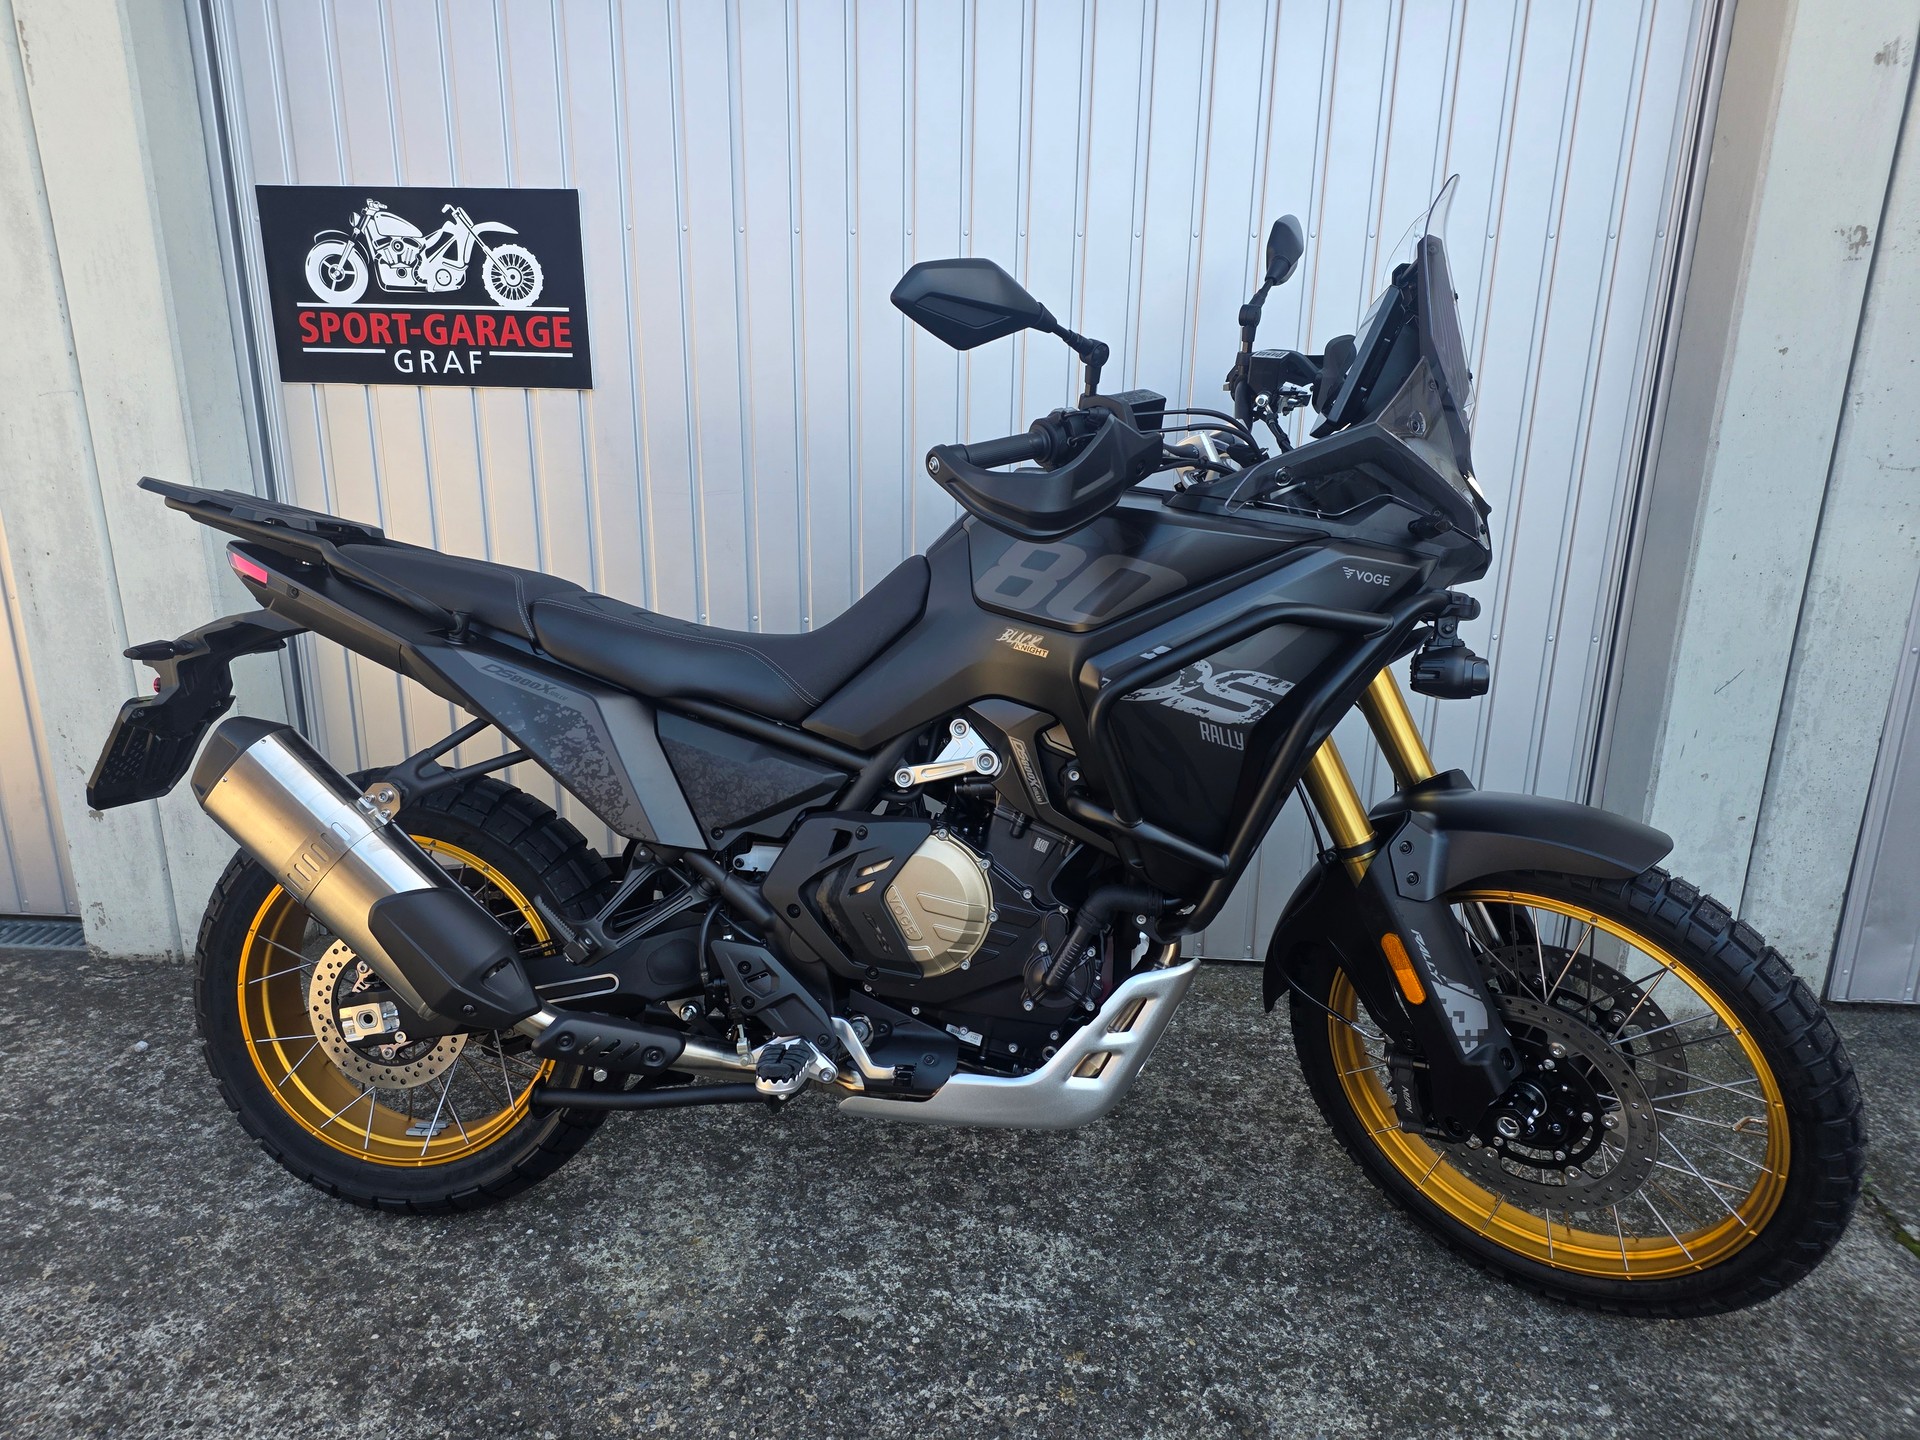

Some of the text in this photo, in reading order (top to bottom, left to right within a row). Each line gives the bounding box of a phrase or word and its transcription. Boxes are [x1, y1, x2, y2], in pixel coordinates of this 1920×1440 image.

[299, 311, 573, 348] SPORT-GARAGE
[393, 349, 482, 374] GRAF
[974, 540, 1188, 624] 80
[1356, 570, 1391, 586] VOGE
[996, 628, 1044, 647] BLACK
[1014, 642, 1048, 657] KNIGHT
[1199, 720, 1245, 751] RALLY
[889, 895, 918, 937] VOGE
[1410, 928, 1447, 985] RALLY
